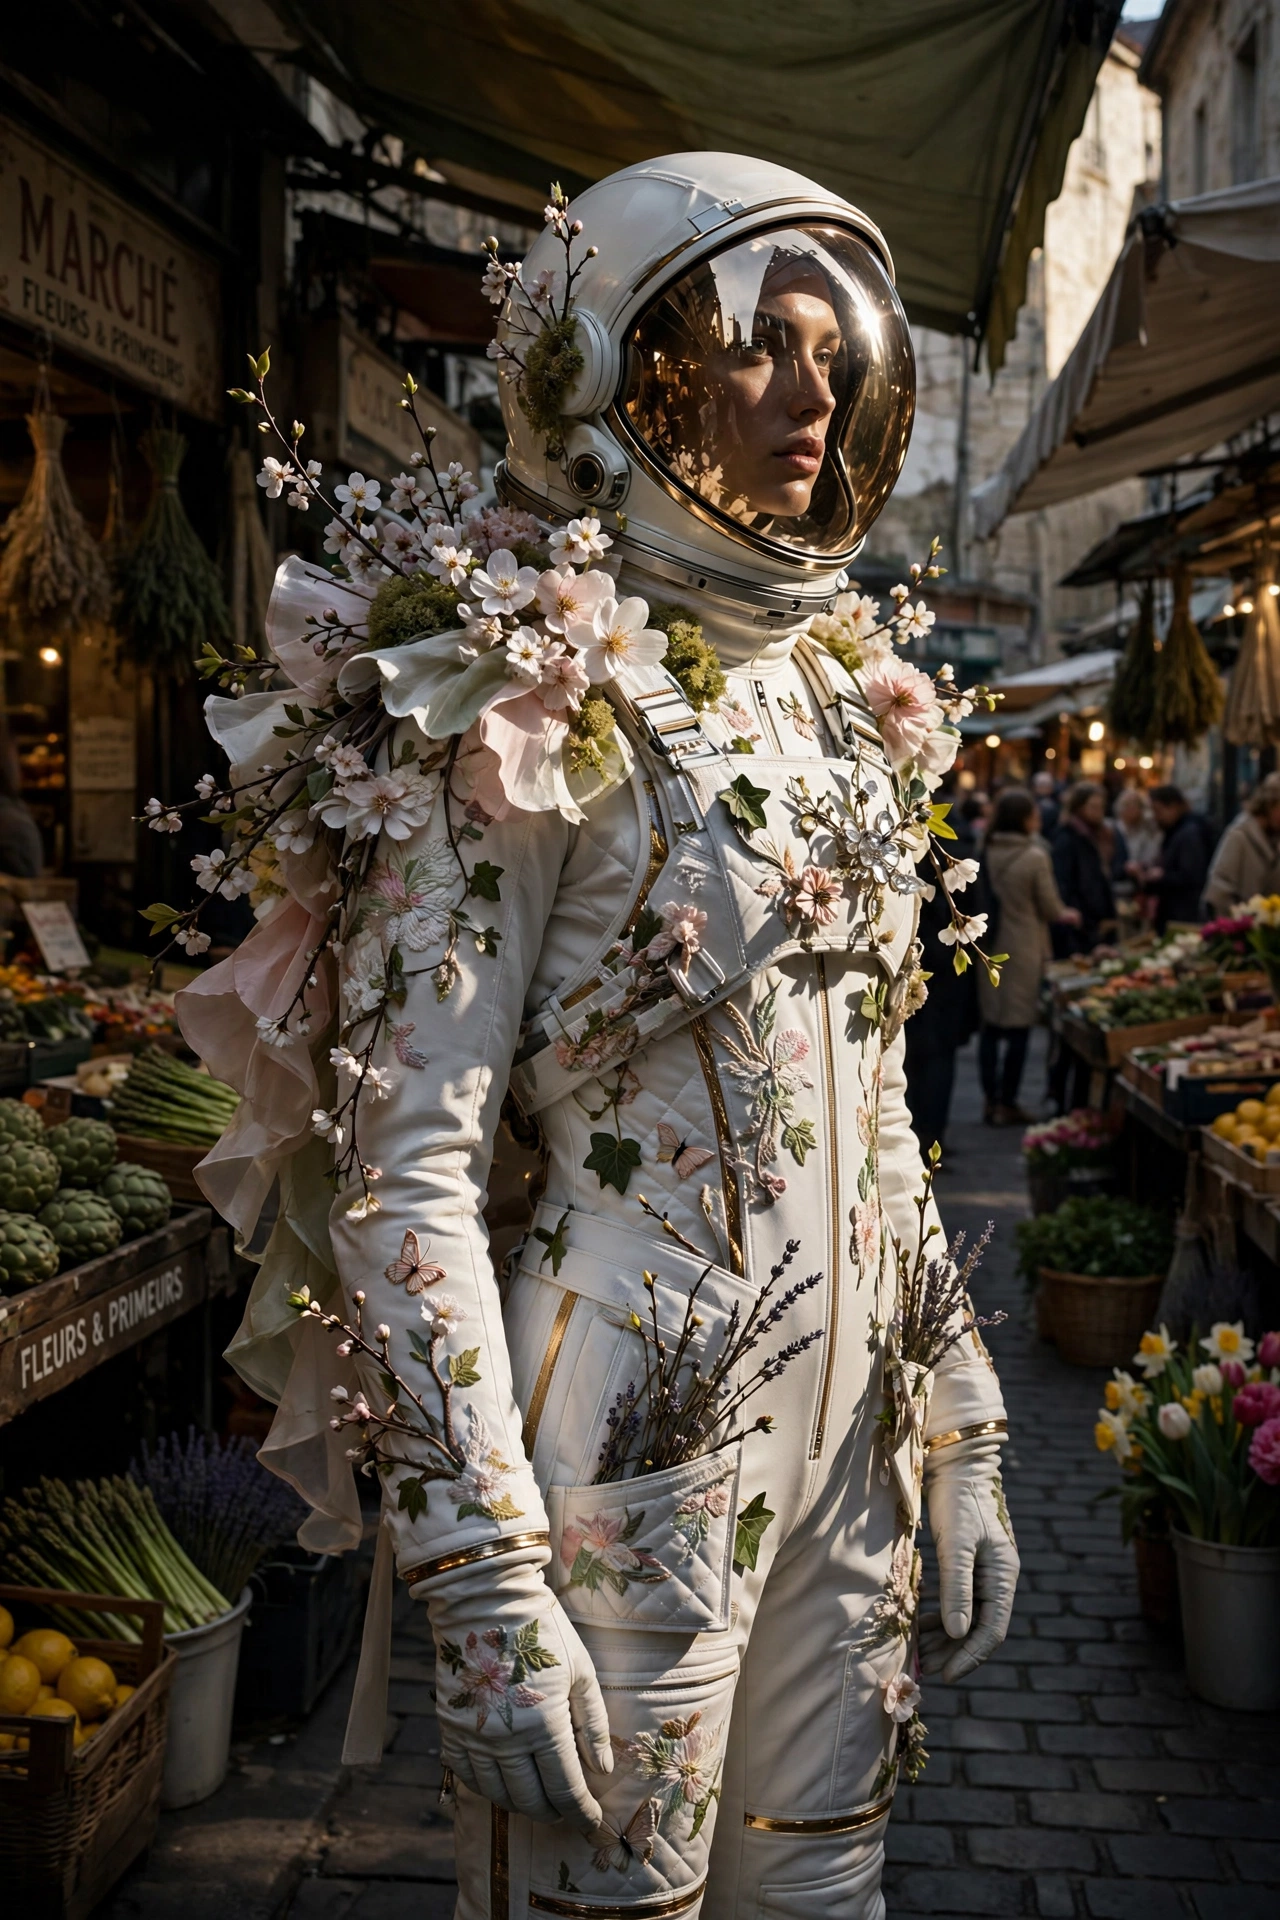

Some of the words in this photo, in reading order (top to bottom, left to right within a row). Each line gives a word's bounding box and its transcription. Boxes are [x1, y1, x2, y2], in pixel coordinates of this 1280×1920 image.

[18, 175, 180, 348] MARCHÉ
[22, 276, 90, 340] FLEURS
[95, 319, 106, 348] &
[20, 1318, 87, 1389] FLEURS
[92, 1311, 104, 1346] &
[108, 1265, 184, 1338] PRIMEURS
